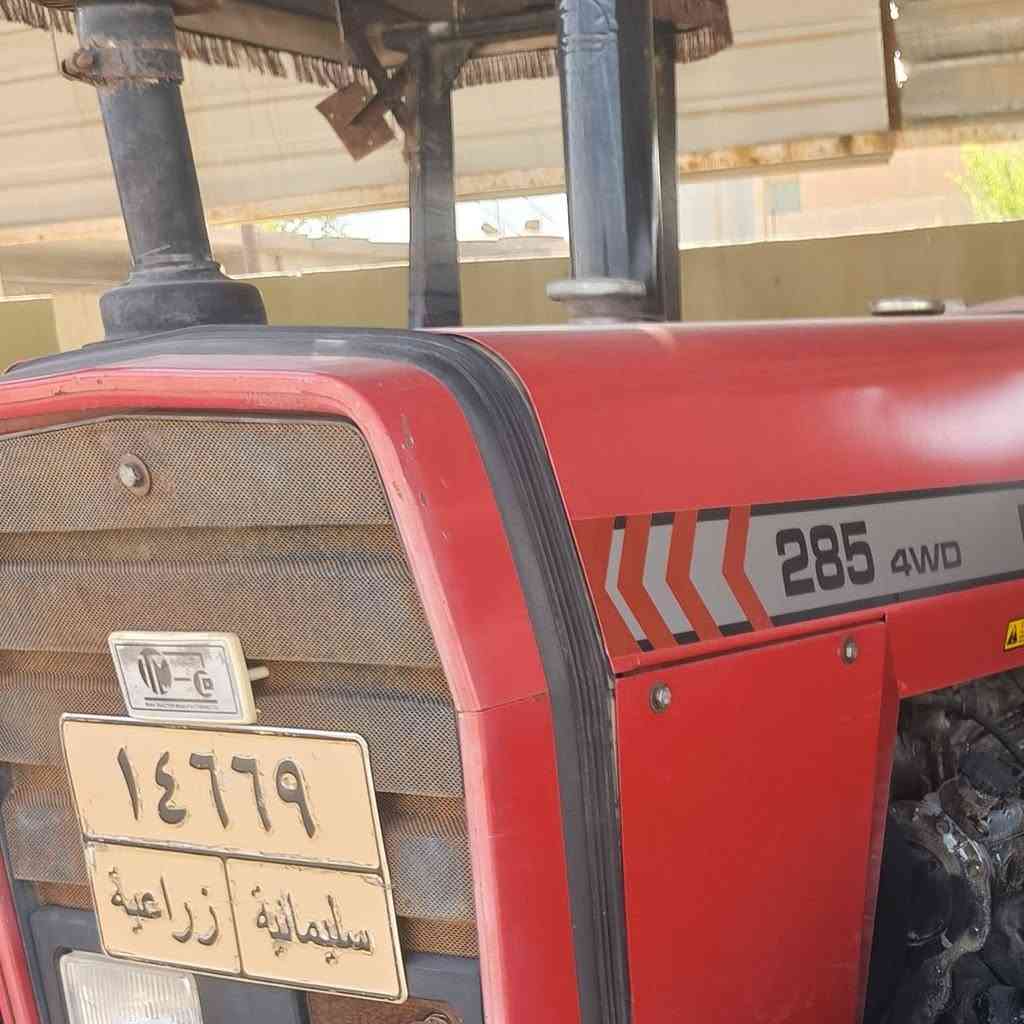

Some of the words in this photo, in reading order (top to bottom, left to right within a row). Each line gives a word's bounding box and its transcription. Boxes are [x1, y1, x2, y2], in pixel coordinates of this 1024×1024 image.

[775, 521, 875, 598] 285
[890, 540, 962, 576] 4WD
[116, 746, 317, 839] ١٤٦٦٩
[108, 867, 221, 947] زراعية
[250, 885, 375, 966] سليمانية
